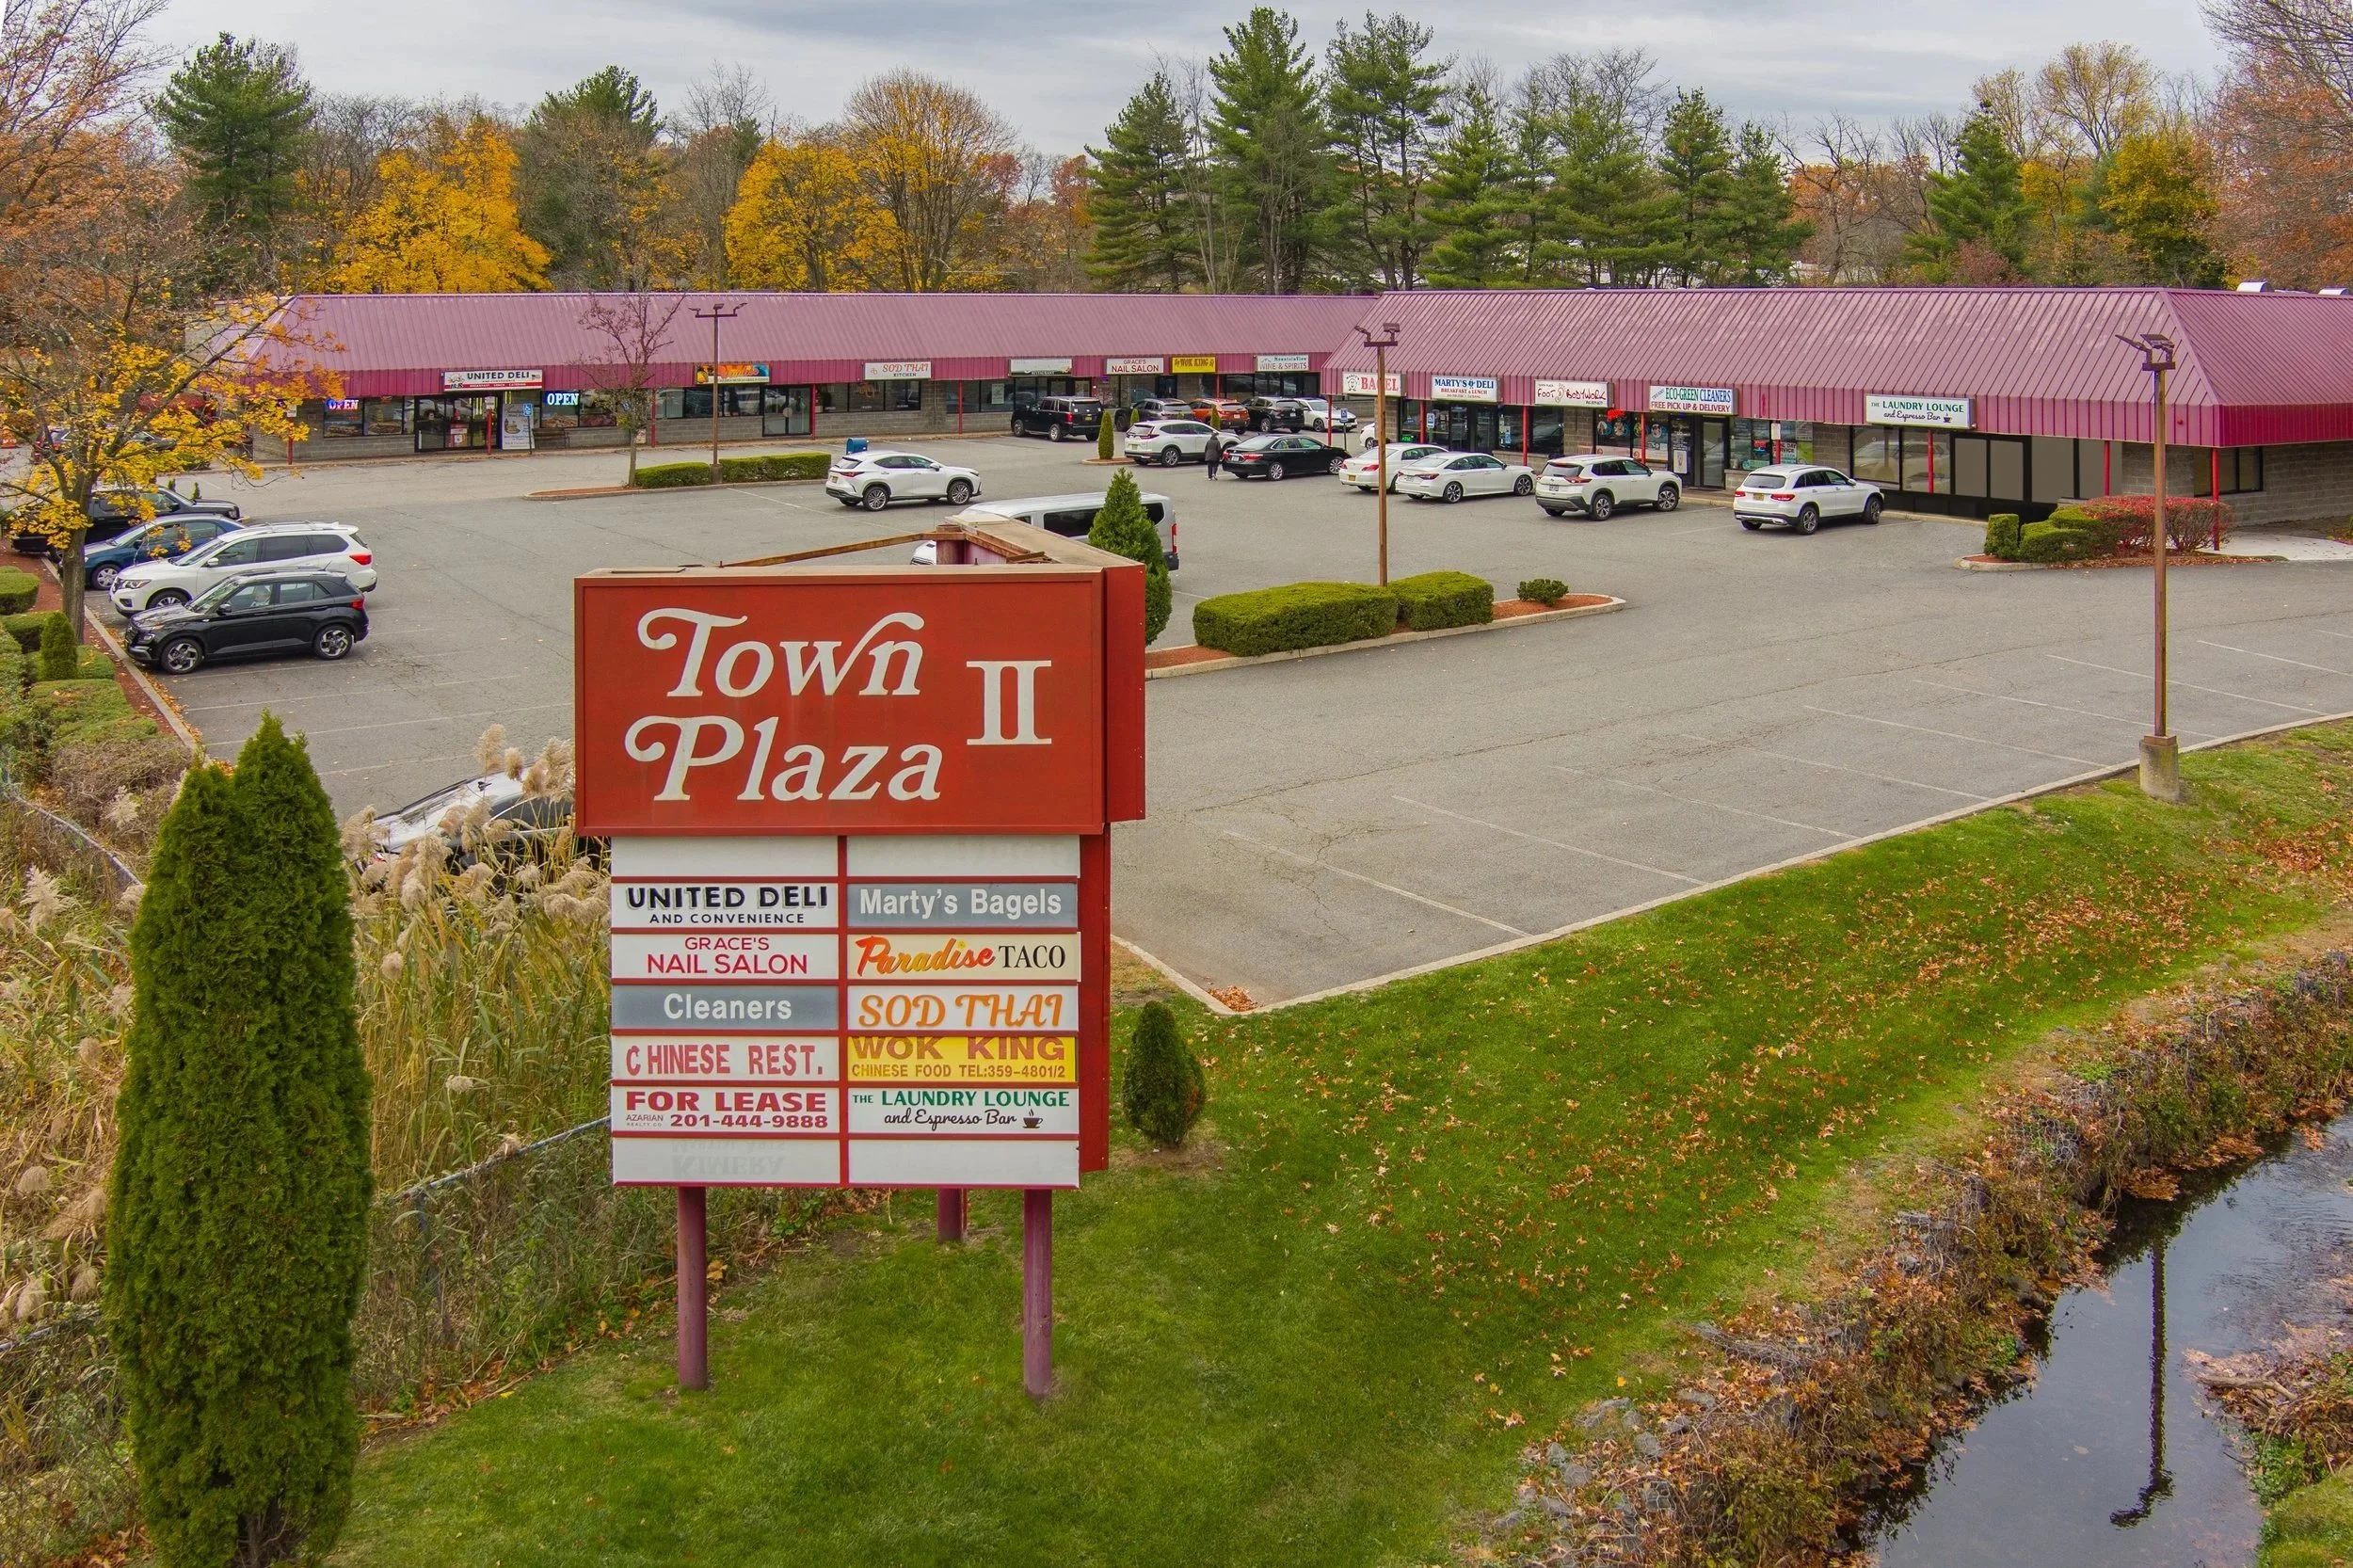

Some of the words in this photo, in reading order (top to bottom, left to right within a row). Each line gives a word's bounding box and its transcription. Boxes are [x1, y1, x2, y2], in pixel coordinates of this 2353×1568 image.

[882, 363, 903, 373] SOD
[904, 362, 929, 372] THAI
[1112, 364, 1129, 373] NAIL
[1131, 364, 1160, 373] SALON
[1284, 361, 1307, 370] SPIRITS
[467, 372, 504, 380] UNITED
[508, 371, 530, 379] DELI
[1361, 376, 1400, 392] BAEL
[1434, 378, 1467, 388] MARTY'S
[1476, 380, 1495, 390] DELI
[547, 392, 580, 406] OPEN
[1537, 388, 1556, 398] FOOT
[1566, 388, 1607, 401] BODYWORK
[1665, 387, 1700, 402] ECO-GREEN
[1700, 389, 1731, 403] CLEANERS
[1651, 401, 1666, 409] FREE
[1667, 402, 1681, 410] PICK
[1683, 403, 1691, 411] UP
[1692, 403, 1698, 411] &
[1699, 403, 1731, 412] DELIVERY
[1882, 400, 1923, 410] LAUNDRY
[1927, 403, 1965, 413] LOUNGE
[1883, 409, 1897, 418] and
[1897, 410, 1926, 422] Espresso
[1927, 412, 1941, 421] Bar
[636, 607, 925, 697] Town
[966, 660, 1052, 745] II
[624, 715, 944, 802] Plaza
[626, 887, 746, 909] UNITED
[758, 886, 828, 908] DELI
[859, 888, 958, 920] Marty's
[970, 888, 1062, 920] Bagels
[649, 914, 683, 923] AND
[690, 913, 805, 924] CONVENIENCE
[684, 936, 770, 951] GRACE'S
[648, 953, 708, 974] NAIL
[714, 953, 808, 974] SALON
[855, 936, 997, 977] Paradise
[998, 944, 1066, 968] TACO
[664, 993, 792, 1019] Cleaners
[858, 994, 946, 1028] SOD
[954, 994, 1064, 1028] THAI
[852, 1036, 944, 1061] WOK
[968, 1036, 1065, 1061] KING
[626, 1044, 731, 1076] CHINESE
[748, 1044, 824, 1076] REST.
[852, 1064, 909, 1078] CHINESE
[915, 1064, 952, 1078] FOOD
[626, 1091, 700, 1112] FOR
[715, 1092, 826, 1112] LEASE
[852, 1095, 873, 1104] THE
[881, 1090, 977, 1107] LAUNDRY
[984, 1091, 1070, 1107] LOUNGE
[625, 1113, 664, 1122] AZARIAN
[670, 1114, 828, 1128] 201-444-9888
[884, 1108, 912, 1124] and
[915, 1109, 982, 1131] Espresso
[984, 1109, 1017, 1125] Bar
